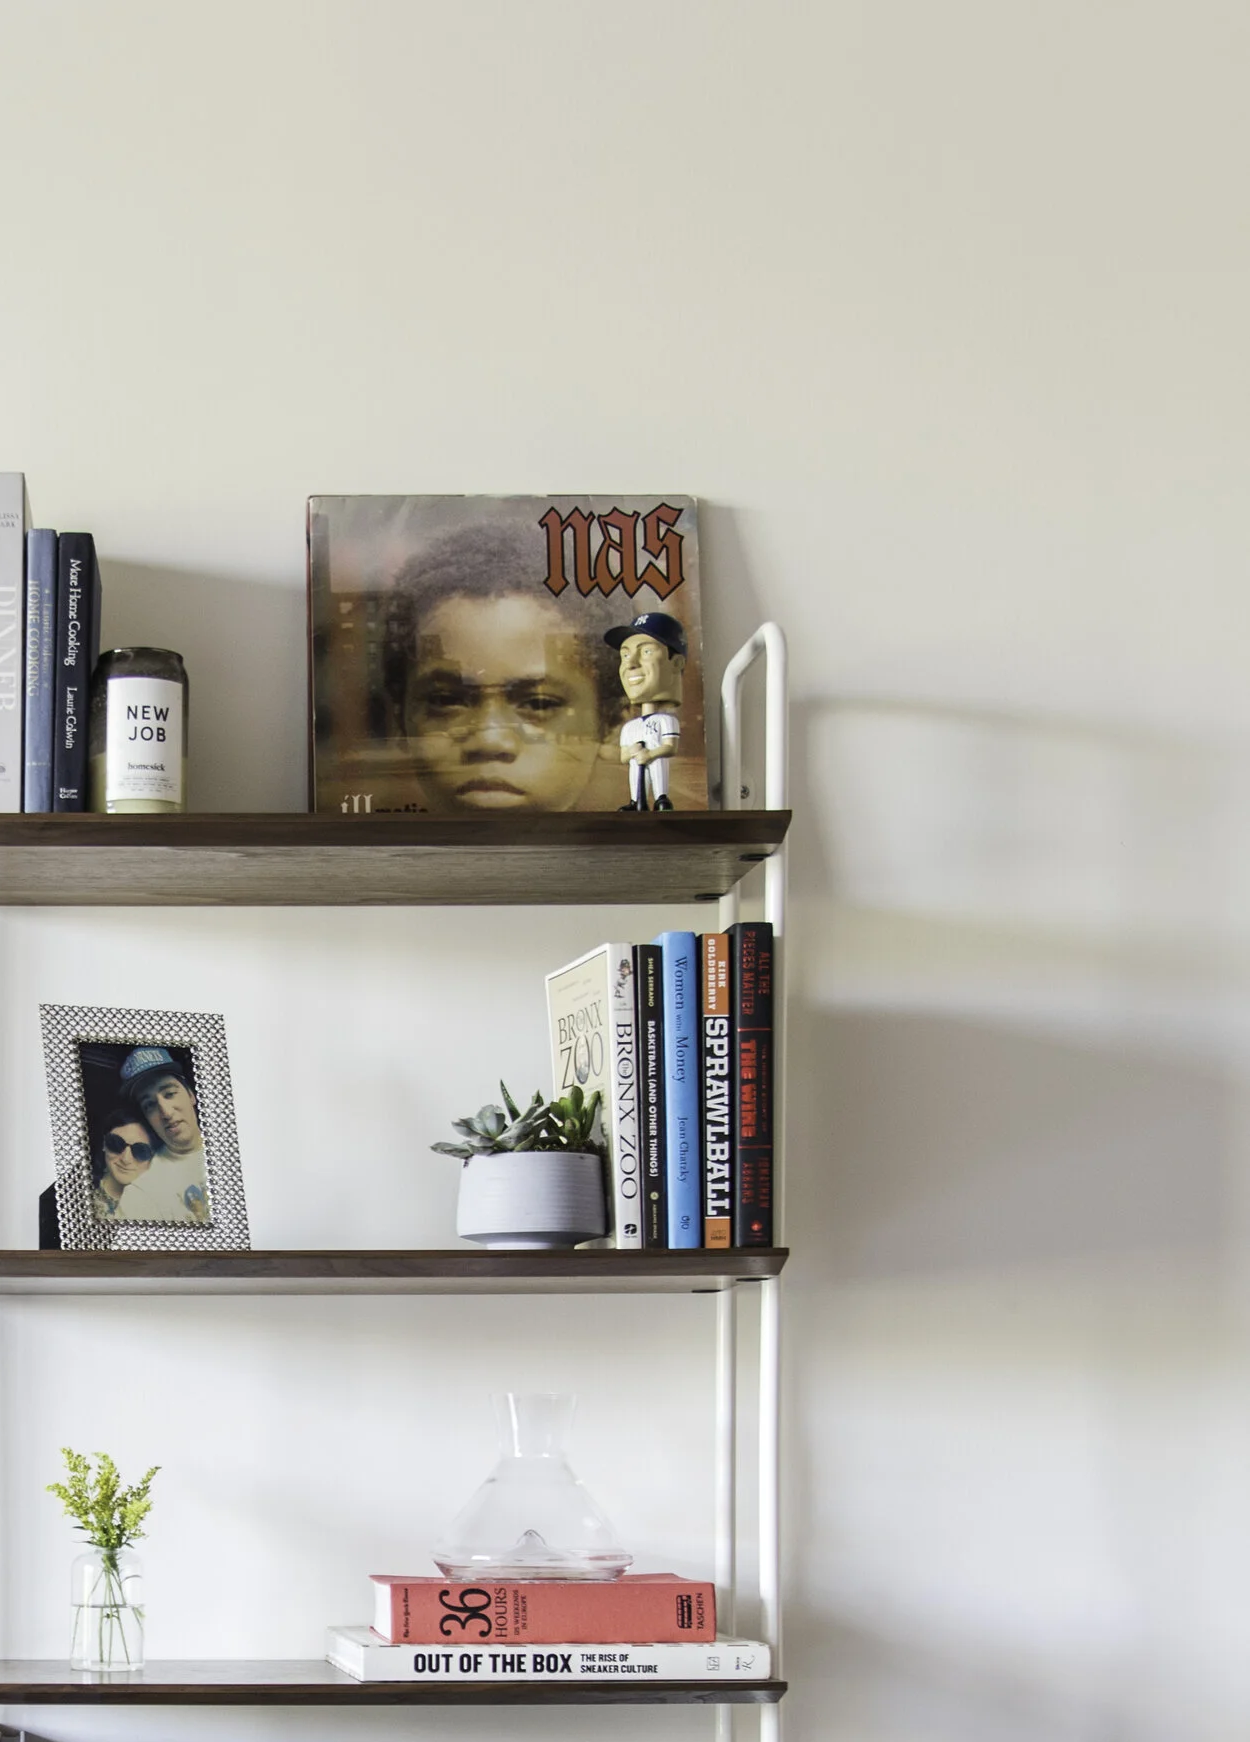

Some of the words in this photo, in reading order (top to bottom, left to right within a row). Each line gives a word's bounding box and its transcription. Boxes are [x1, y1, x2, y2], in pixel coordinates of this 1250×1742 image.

[538, 502, 685, 601] nas
[69, 558, 82, 587] More
[27, 580, 40, 624] HOME
[68, 588, 81, 620] Home
[27, 627, 40, 697] COOKING
[63, 620, 81, 667] Cooking
[66, 686, 78, 715] Laurie
[126, 705, 170, 722] NEW
[65, 715, 77, 749] Colwin
[128, 726, 166, 743] JOB
[127, 762, 166, 772] homesick
[647, 957, 655, 975] SHEA
[742, 931, 756, 969] PIECES
[758, 951, 770, 970] ALL
[647, 976, 655, 1008] SERRANO
[674, 956, 688, 1011] Women
[707, 938, 717, 1010] GOLDSBERRY
[718, 961, 726, 988] KIRK
[758, 974, 770, 995] THE
[741, 971, 756, 1016] MATTER
[557, 999, 603, 1045] BRONX
[560, 1031, 603, 1090] ZOO
[647, 1020, 657, 1076] BASKETBALL
[672, 1036, 689, 1084] Money
[616, 1022, 635, 1124] BRONX
[648, 1078, 657, 1103] (AND
[648, 1106, 657, 1136] OTHER
[677, 1116, 688, 1140] Jean
[705, 1018, 730, 1217] SPRAWLBALL
[619, 1135, 638, 1200] ZOO
[649, 1138, 659, 1178] THINGS)
[677, 1141, 689, 1183] Chatzky
[438, 1587, 492, 1638] 36
[494, 1587, 508, 1638] HOURS
[696, 1592, 705, 1631] TASCHEN
[413, 1653, 453, 1674] OUT
[459, 1653, 483, 1674] OF
[488, 1653, 527, 1674] THE
[532, 1653, 573, 1674] BOX
[580, 1653, 597, 1663] THE
[598, 1653, 617, 1663] RISE
[618, 1653, 630, 1663] OF
[580, 1664, 619, 1674] SNEAKER
[620, 1664, 659, 1674] CULTURE
